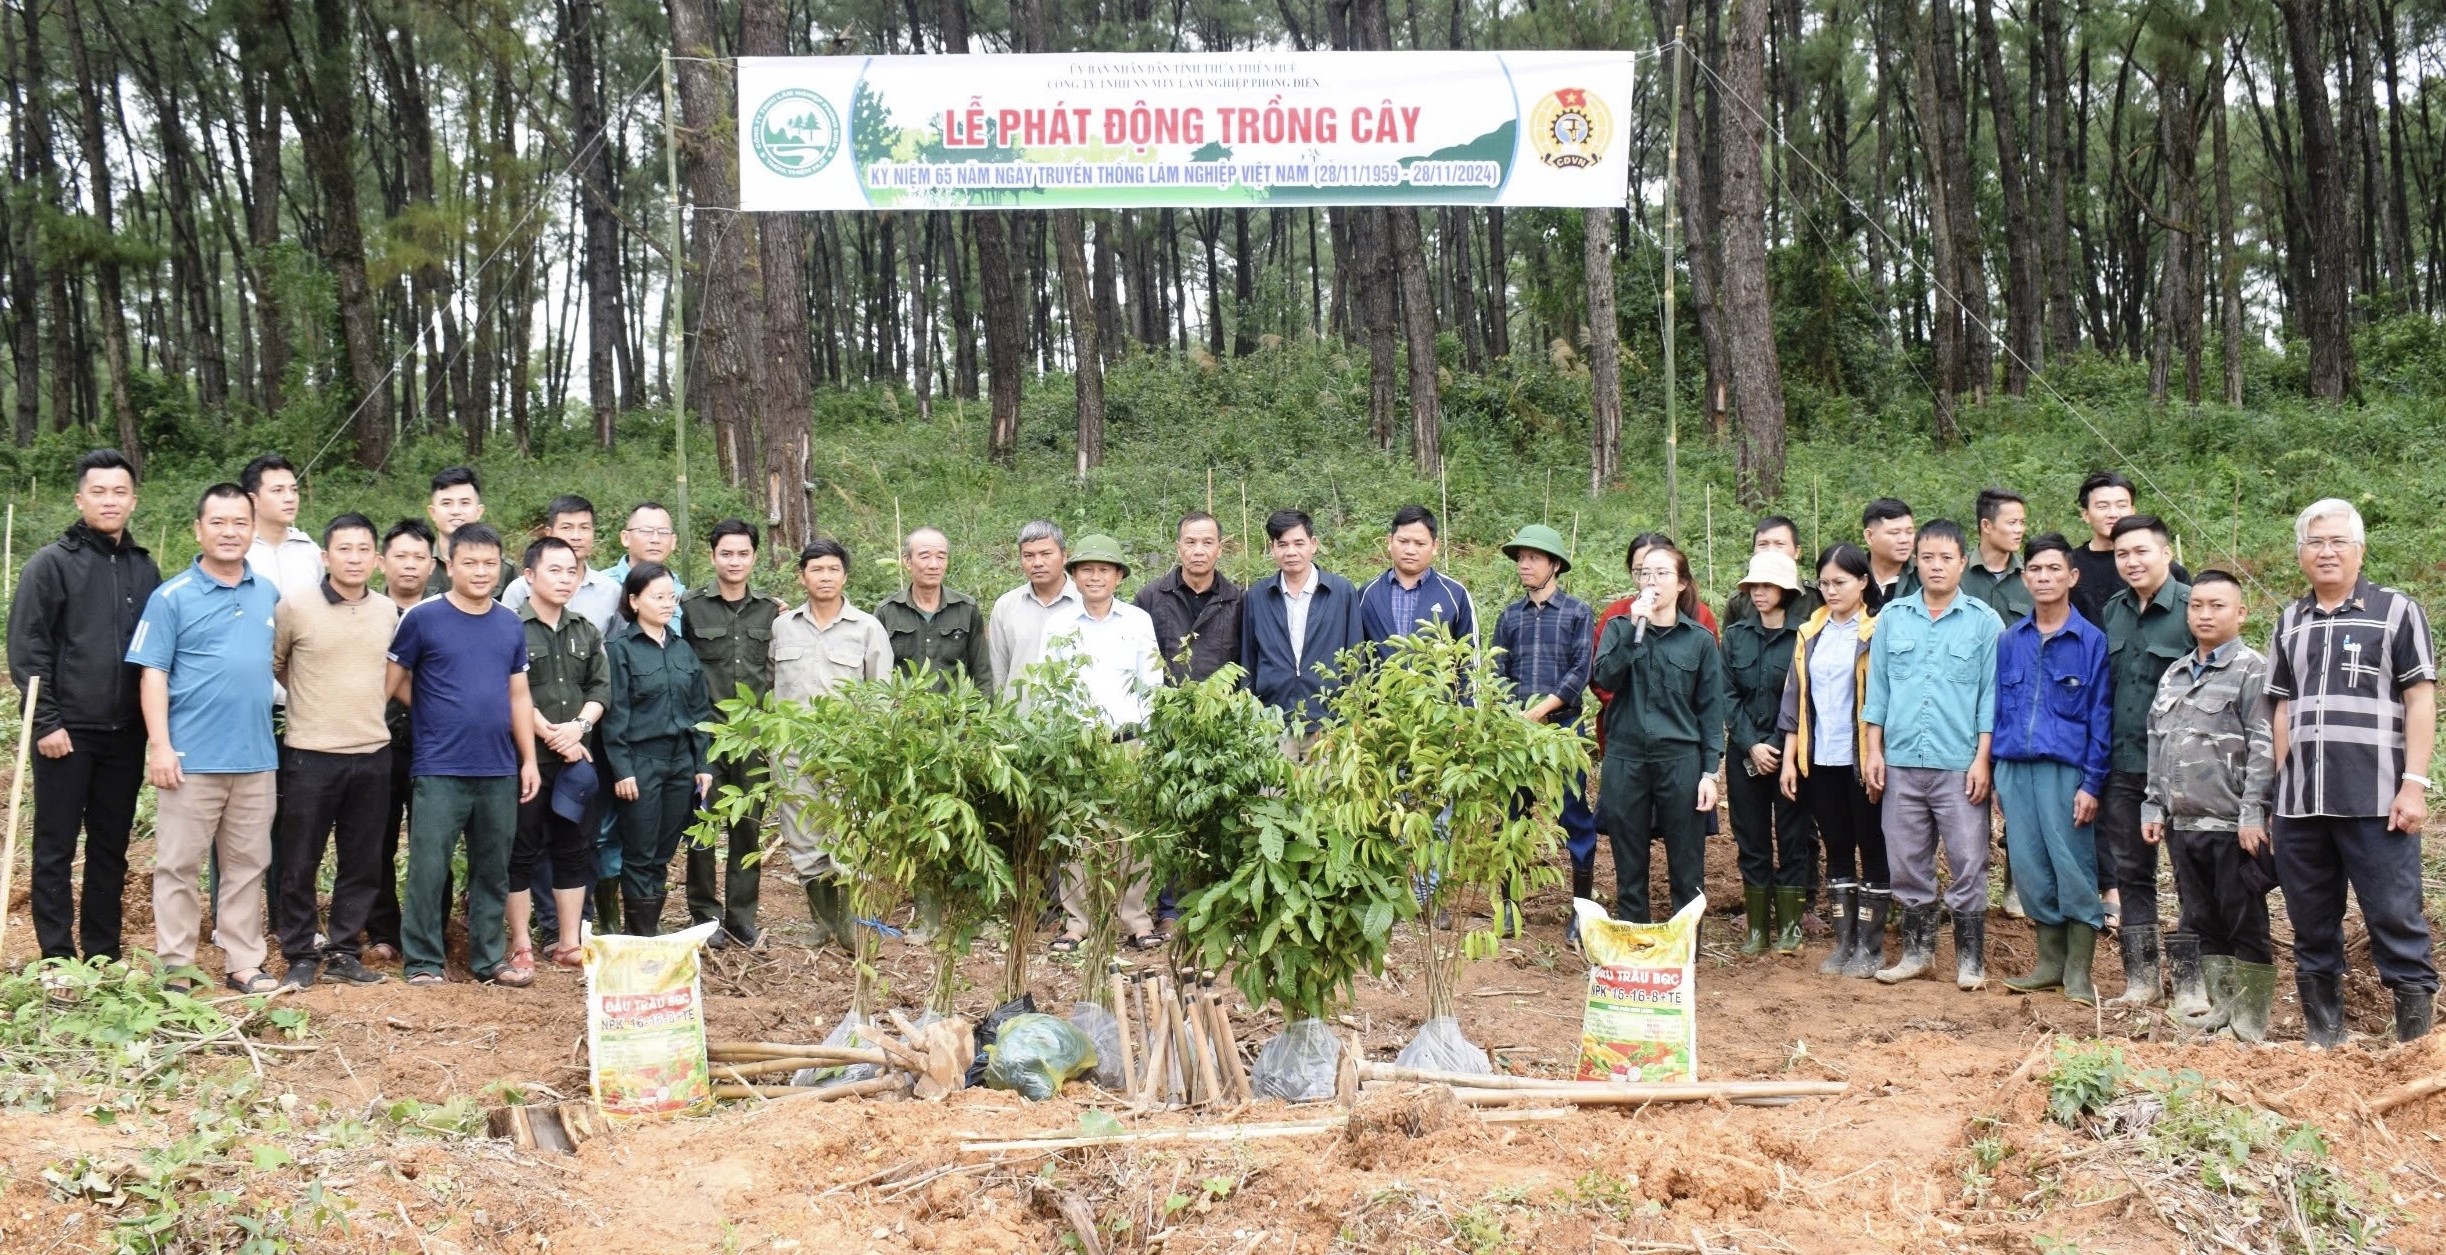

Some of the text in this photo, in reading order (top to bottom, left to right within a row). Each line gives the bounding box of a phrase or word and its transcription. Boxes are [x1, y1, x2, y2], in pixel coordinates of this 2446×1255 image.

[946, 94, 1421, 153] LỄ PHÁT ĐỘNG TRỒNG CÂY
[935, 168, 951, 185] 65
[957, 164, 990, 185] NĂM
[995, 163, 1033, 185] NGÀY
[1150, 162, 1179, 183] LÂM
[1184, 161, 1236, 187] NGHIỆP
[1241, 161, 1271, 187] VIỆT
[1276, 165, 1309, 183] NAM
[1314, 164, 1398, 184] (28/11/1959
[1413, 164, 1497, 183] 28/11/2024)
[1591, 984, 1607, 998] NPK
[601, 1018, 624, 1031] NPK
